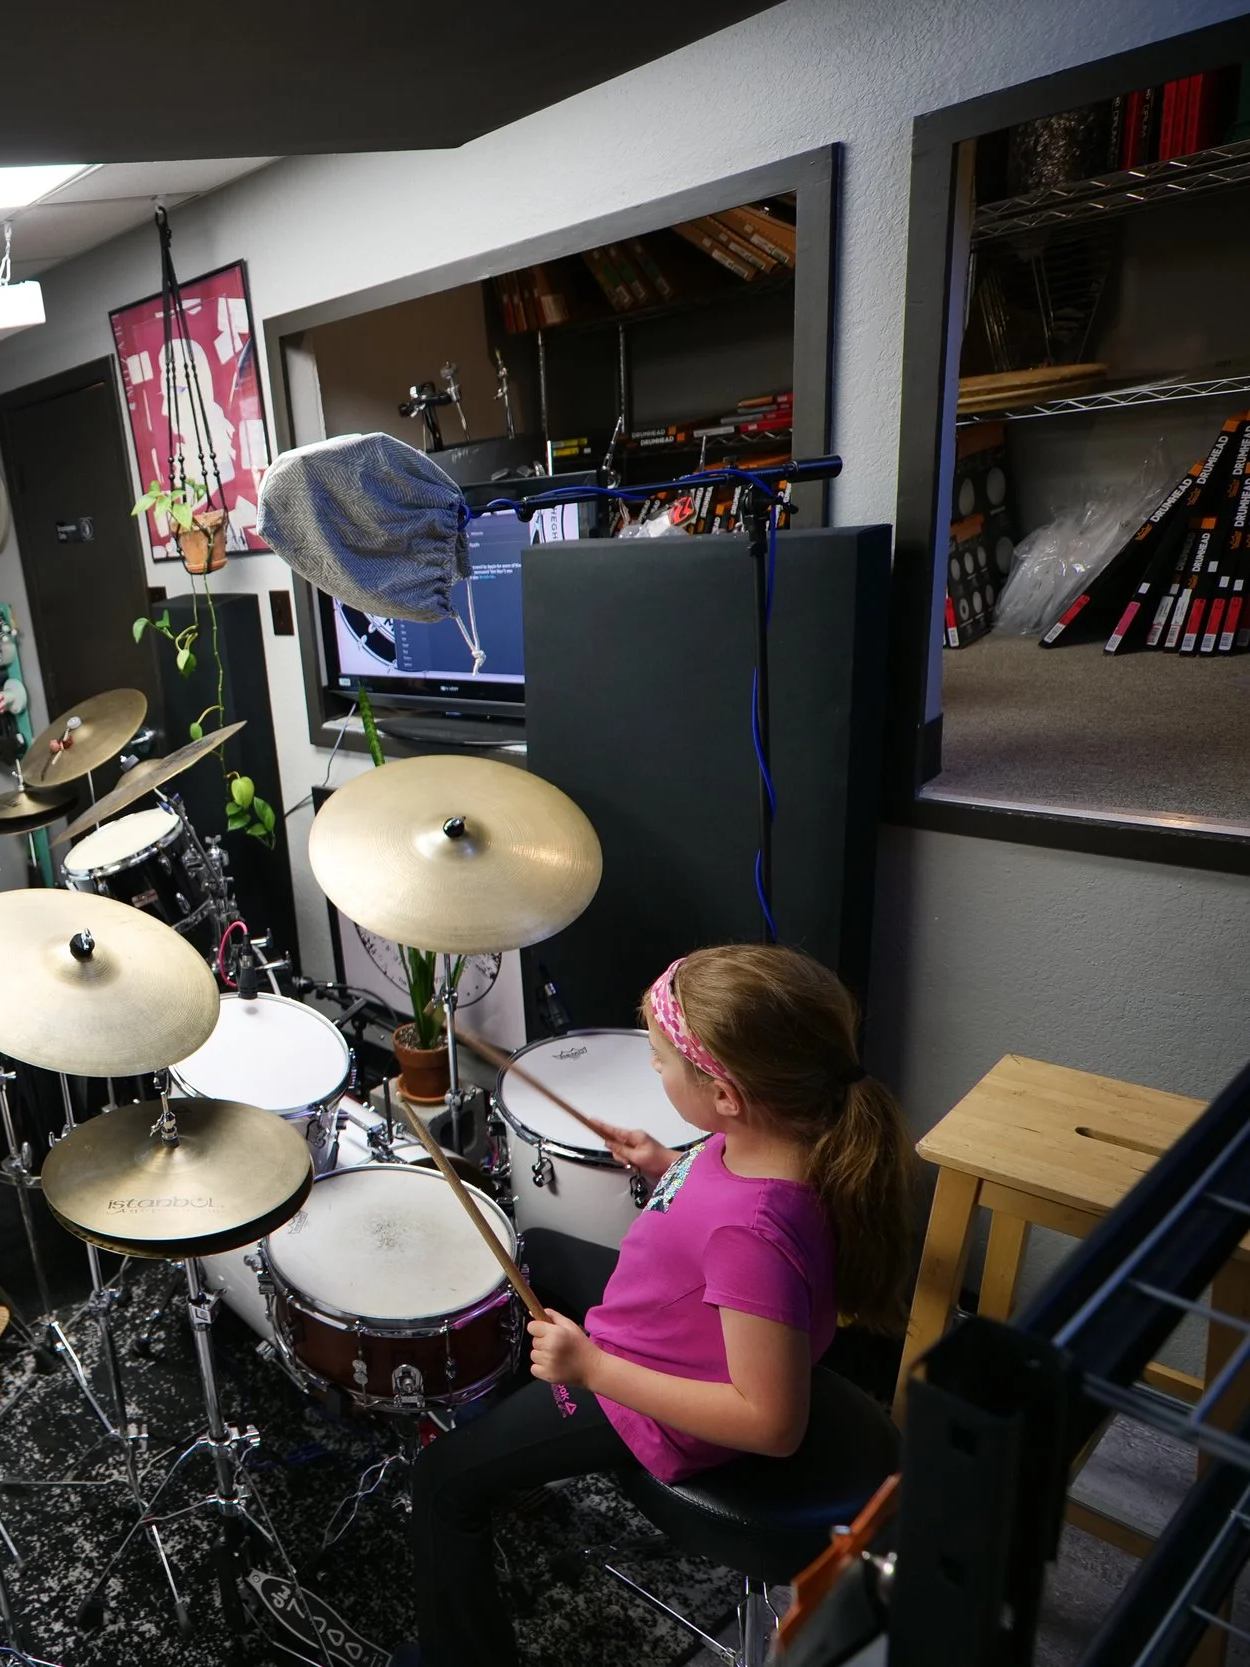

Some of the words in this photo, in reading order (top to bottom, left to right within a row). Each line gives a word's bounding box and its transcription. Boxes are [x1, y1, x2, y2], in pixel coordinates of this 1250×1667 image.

[1197, 435, 1229, 485] DRUMHEAD
[1151, 478, 1192, 523] DRUMHEAD
[1191, 533, 1211, 573] DRUMHEAD
[270, 1584, 292, 1609] dw
